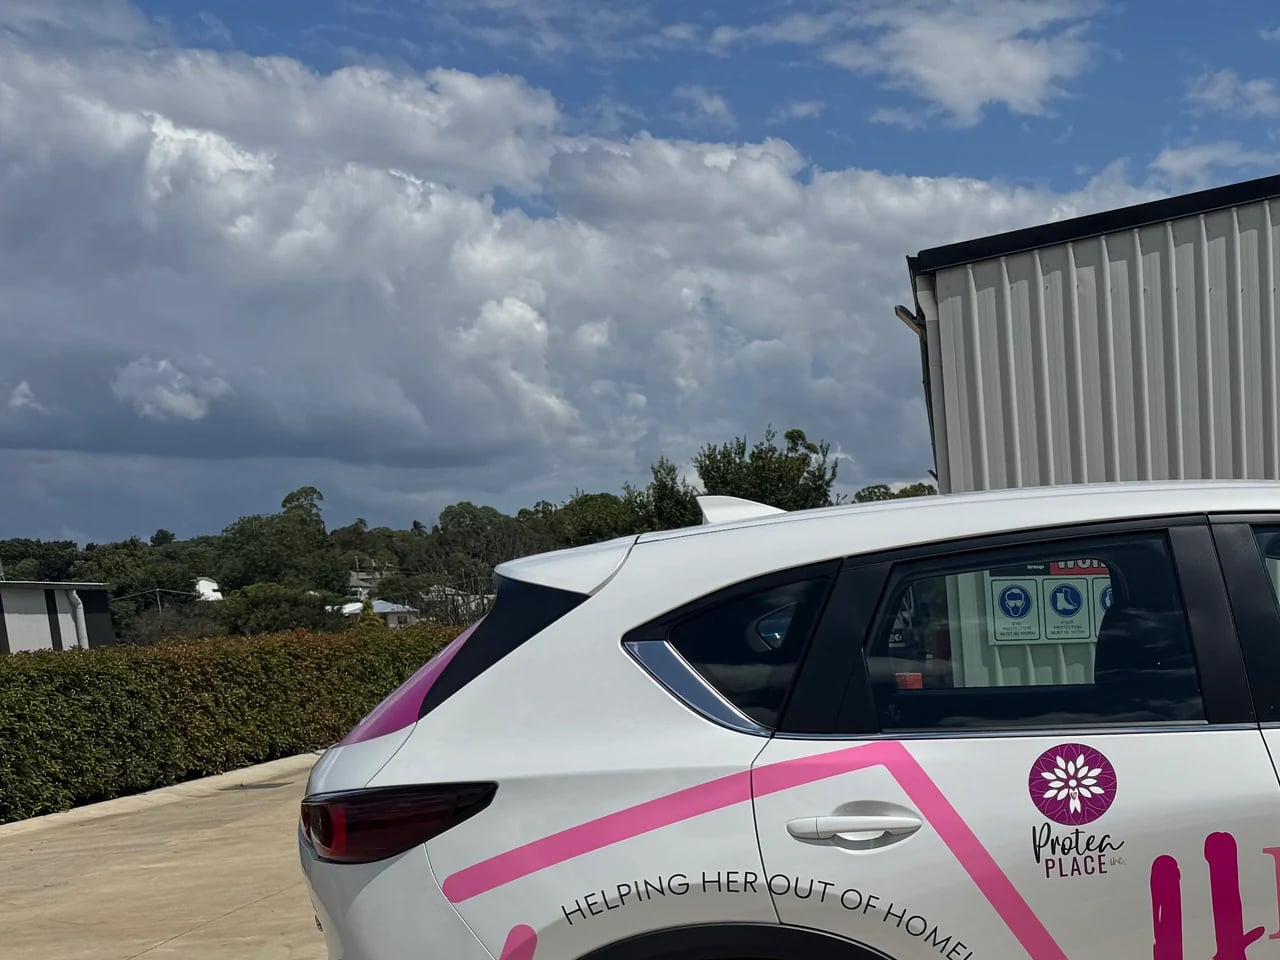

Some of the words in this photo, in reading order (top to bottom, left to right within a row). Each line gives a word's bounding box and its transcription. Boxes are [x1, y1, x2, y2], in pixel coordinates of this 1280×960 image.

[1032, 822, 1125, 863] Protea
[1045, 854, 1108, 878] PLACE
[560, 872, 690, 926] HELPING
[702, 871, 758, 894] HER
[767, 873, 835, 903] OUT
[840, 888, 881, 916] OF
